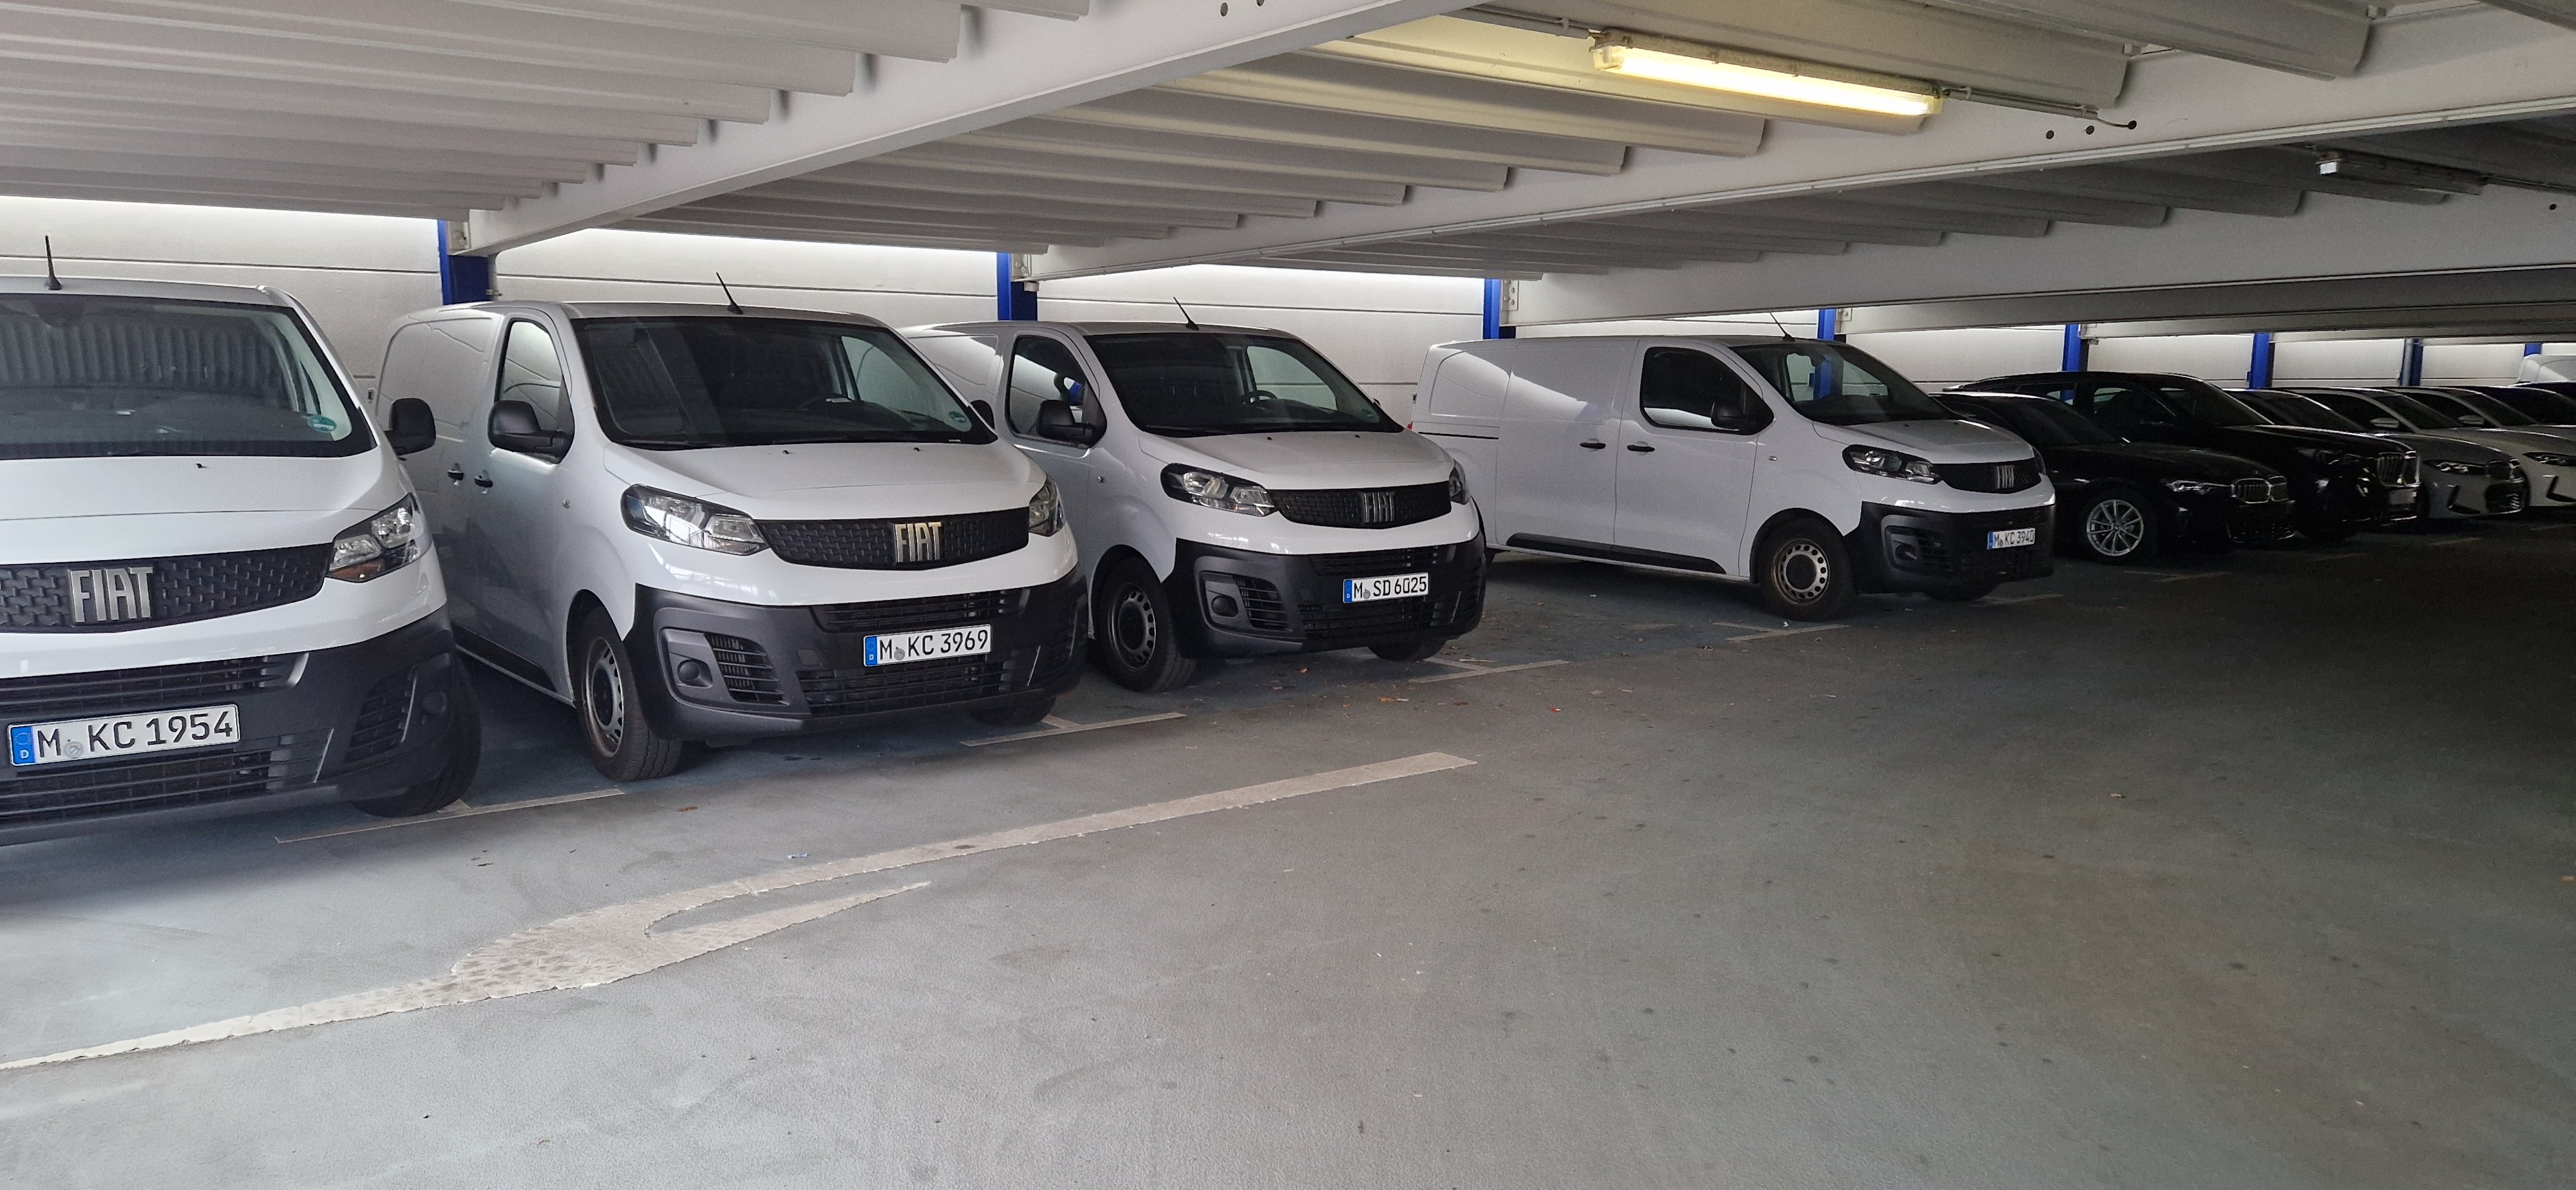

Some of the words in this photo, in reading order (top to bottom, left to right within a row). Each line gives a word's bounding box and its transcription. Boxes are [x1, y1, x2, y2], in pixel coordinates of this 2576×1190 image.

[1364, 492, 1395, 522] FIAT
[894, 521, 942, 563] FIAT
[1994, 533, 2000, 546] M
[2005, 532, 2014, 545] KC
[68, 566, 154, 623] FIAT
[1354, 582, 1363, 599] M
[1373, 580, 1391, 597] SD
[1394, 576, 1427, 594] 6025
[879, 639, 893, 661] M
[908, 635, 934, 657] KC
[940, 629, 988, 654] 3969
[37, 728, 61, 758] M
[88, 721, 136, 752] KC
[146, 711, 233, 746] 1954
[19, 750, 30, 759] D
